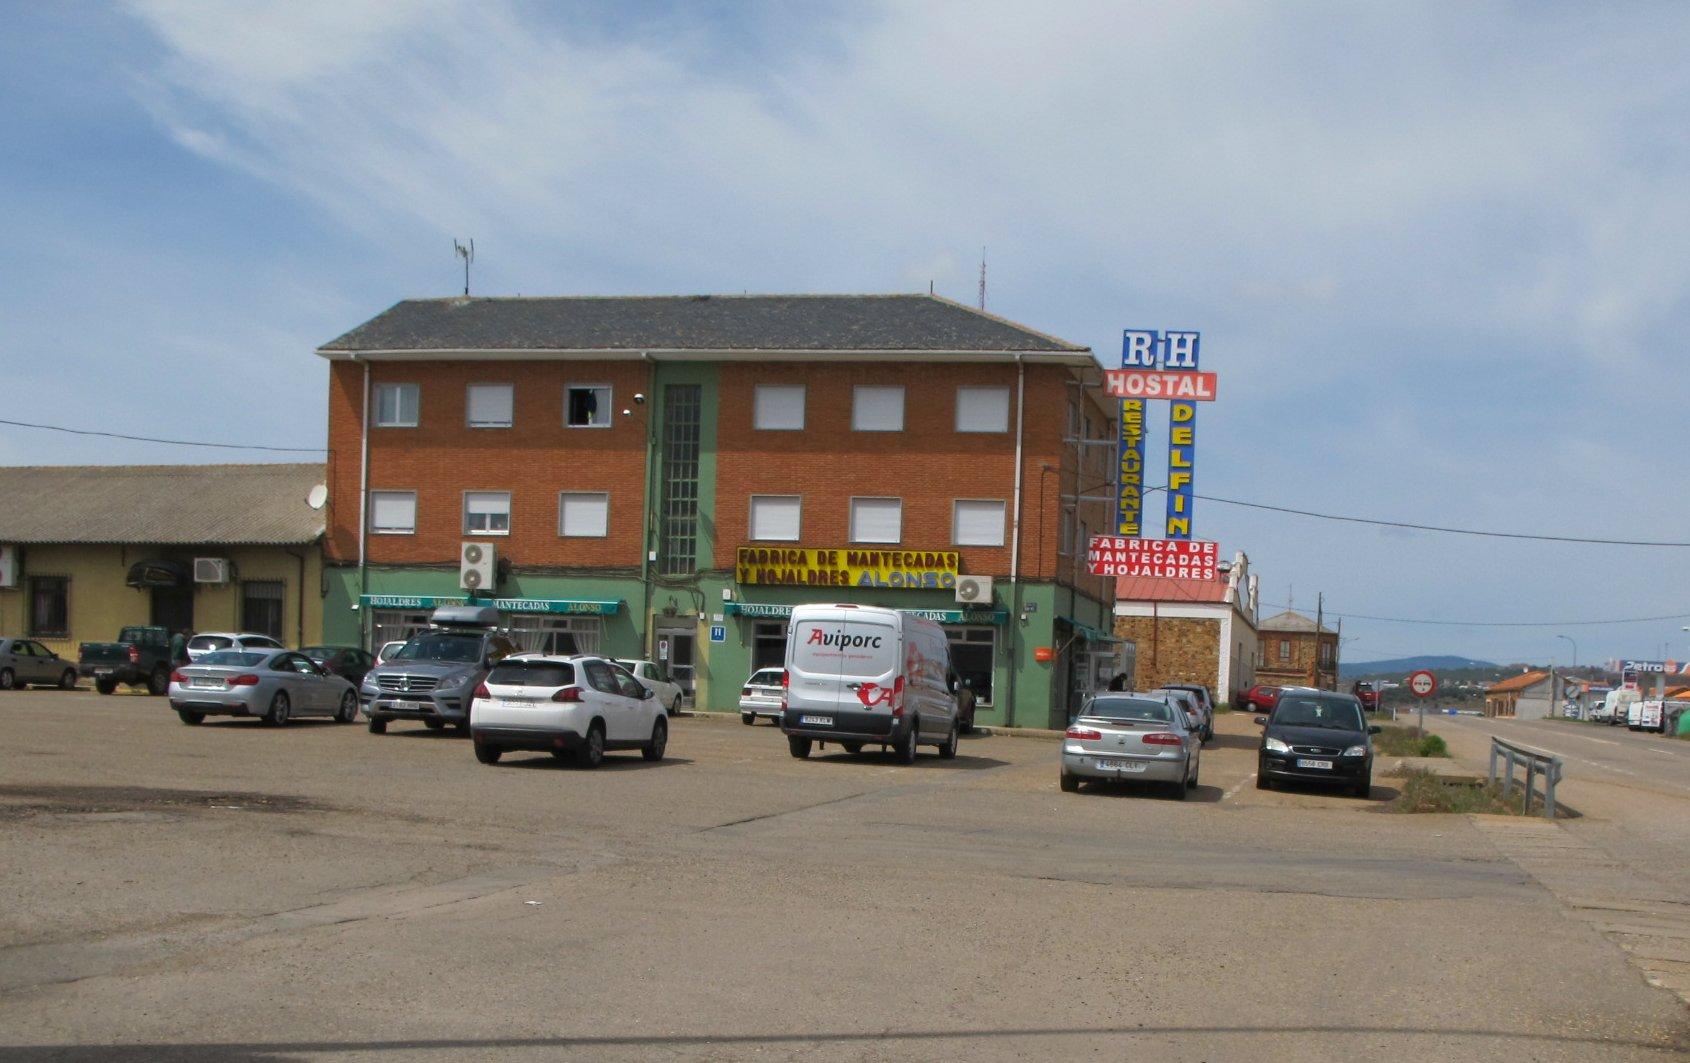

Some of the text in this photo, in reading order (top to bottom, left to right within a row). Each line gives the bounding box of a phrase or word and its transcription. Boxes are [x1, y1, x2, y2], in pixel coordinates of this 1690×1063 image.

[1106, 373, 1211, 397] HOSTAL
[1119, 400, 1142, 534] RESTAURANTE
[1168, 404, 1193, 535] DELFIN
[1090, 537, 1214, 554] FABRICA DE
[739, 550, 956, 568] FABRICA DE MANTECADAS
[1088, 550, 1214, 567] MANTECADAS
[740, 568, 957, 587] Y HOJALDRES ALONSO
[1088, 563, 1213, 579] Y HOJALDRES
[370, 597, 422, 606] HOJALDRES
[493, 601, 600, 611] MANTECADAS ALONSO
[741, 605, 792, 615] HOJALDRE
[807, 629, 882, 651] Aviporc
